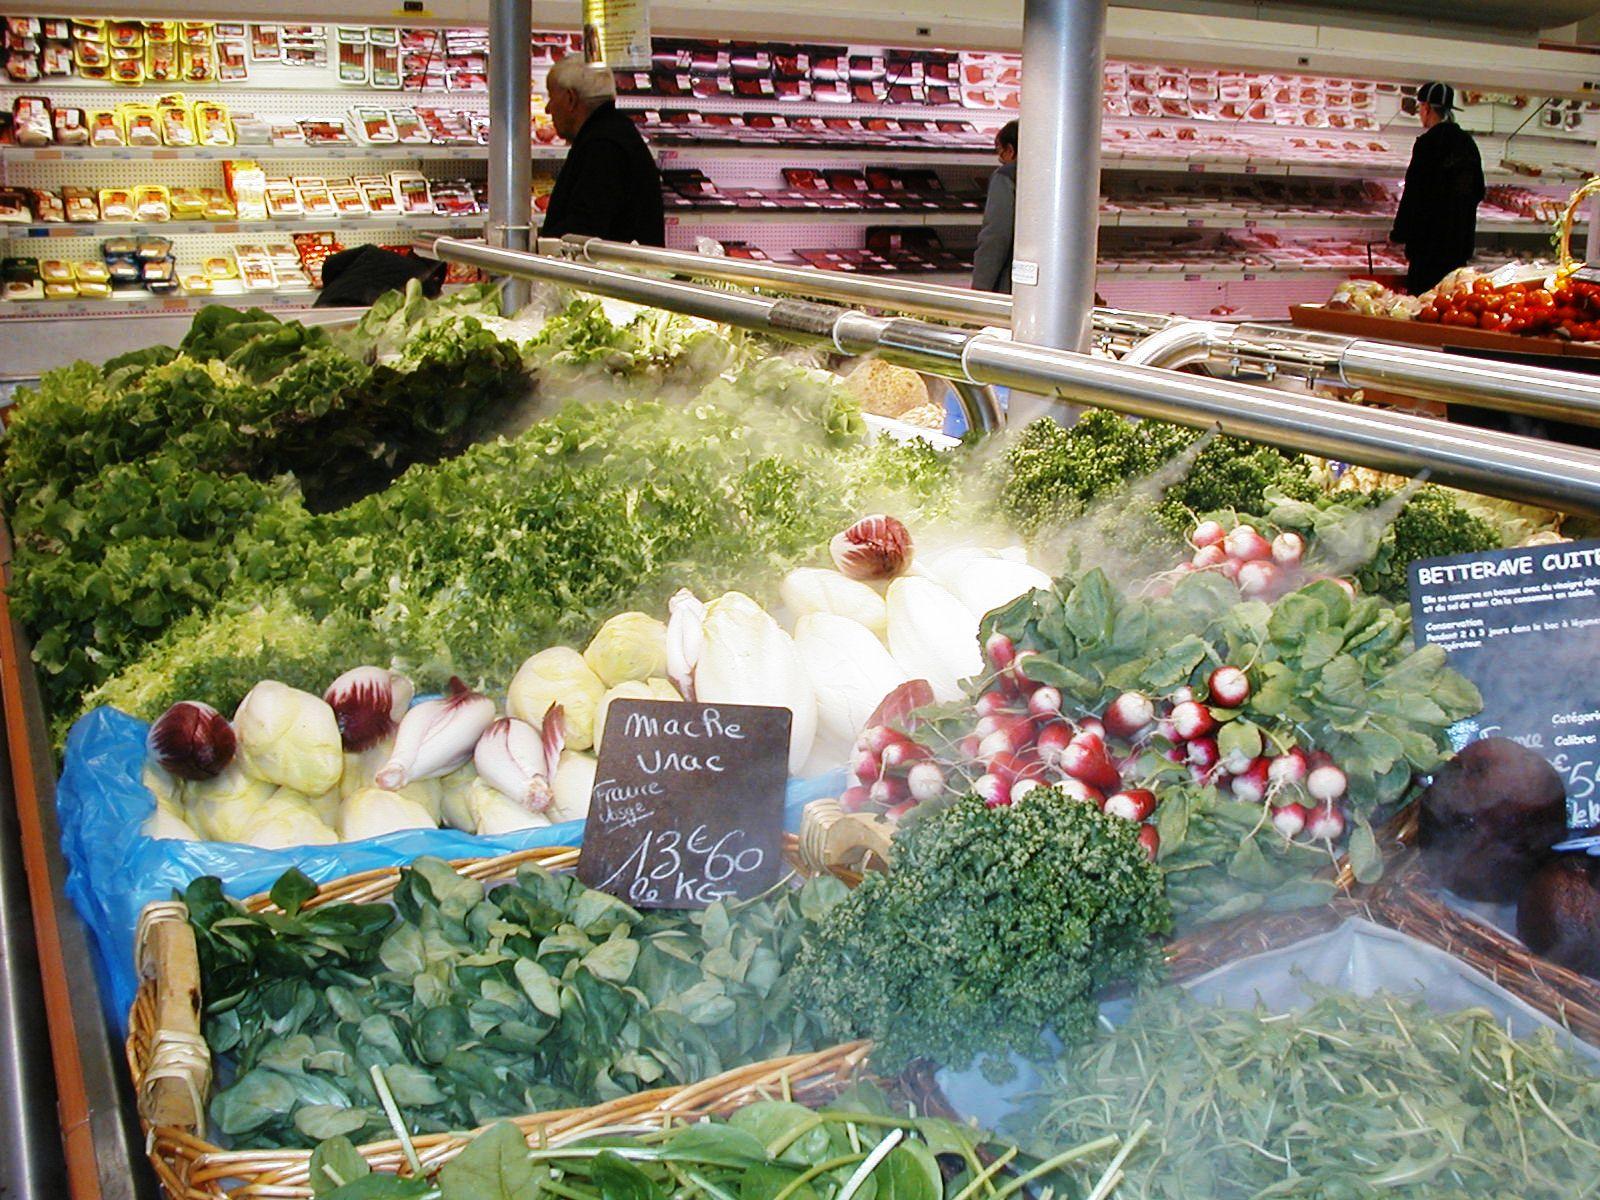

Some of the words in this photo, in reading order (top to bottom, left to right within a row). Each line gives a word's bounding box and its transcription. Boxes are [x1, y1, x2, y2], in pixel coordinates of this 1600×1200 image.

[1418, 556, 1533, 585] BETTERAVE
[1552, 581, 1583, 590] vinaigre
[1425, 618, 1483, 631] Conservation
[1488, 627, 1510, 638] jours
[1554, 734, 1597, 747] Calibre:
